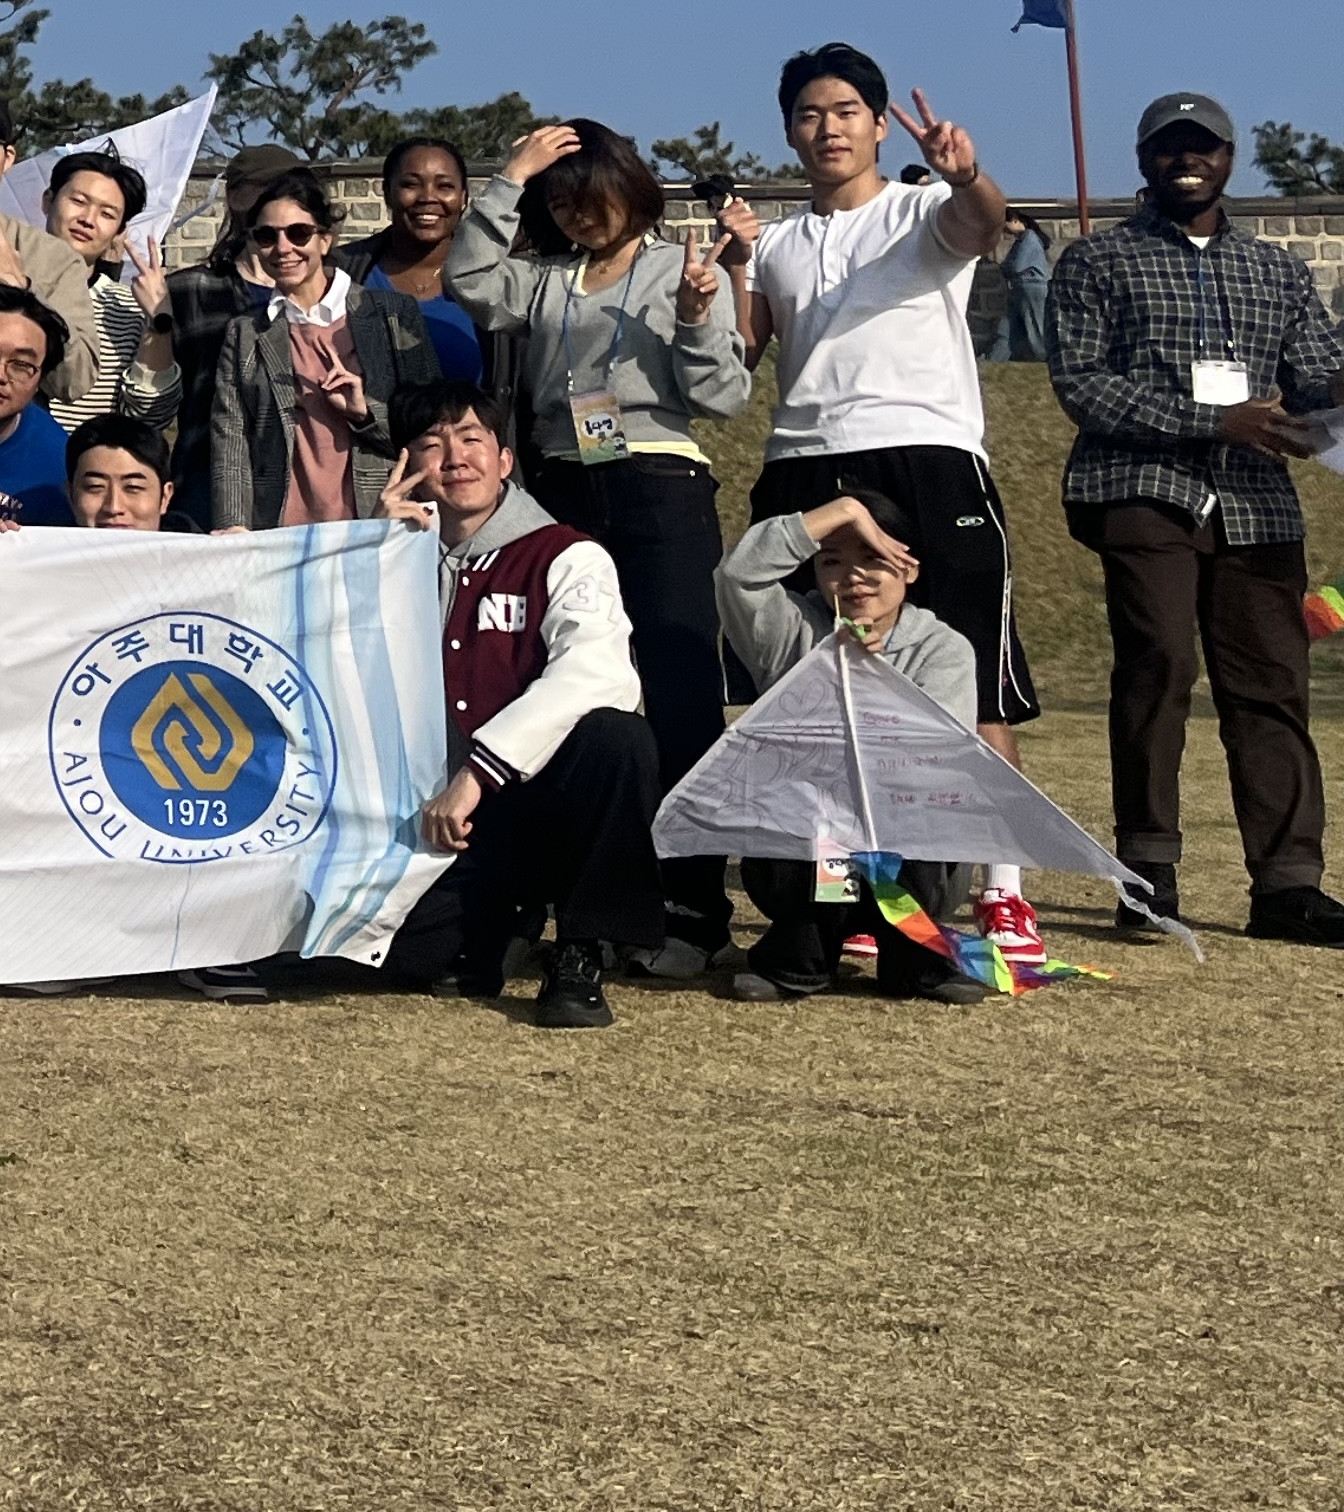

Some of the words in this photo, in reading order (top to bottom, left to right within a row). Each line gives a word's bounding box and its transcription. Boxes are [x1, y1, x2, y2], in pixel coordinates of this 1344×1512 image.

[71, 623, 303, 712] 아주대학교
[63, 751, 137, 841] AJOU
[163, 799, 229, 827] 1973
